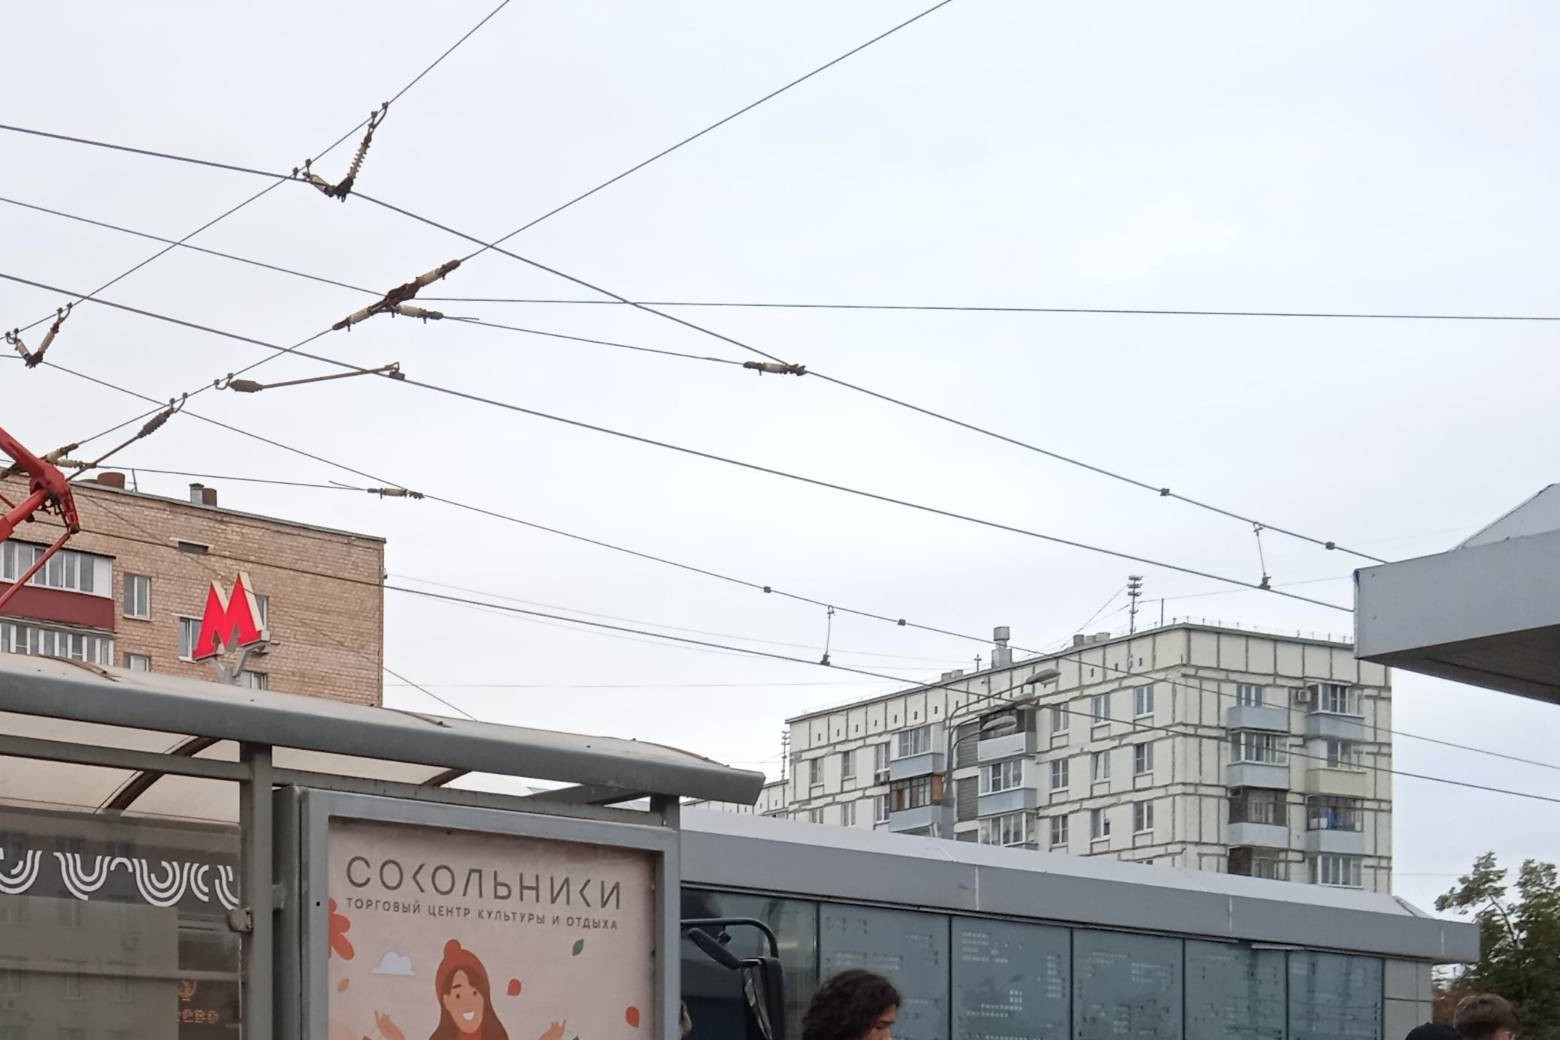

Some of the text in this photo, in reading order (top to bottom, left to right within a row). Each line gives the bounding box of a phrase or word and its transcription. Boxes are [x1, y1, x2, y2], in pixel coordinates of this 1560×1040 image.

[346, 897, 618, 930] ТОРГОВЫЙ ЦЕНТР КУЛЬТУРЫ И ОТДЫХА
